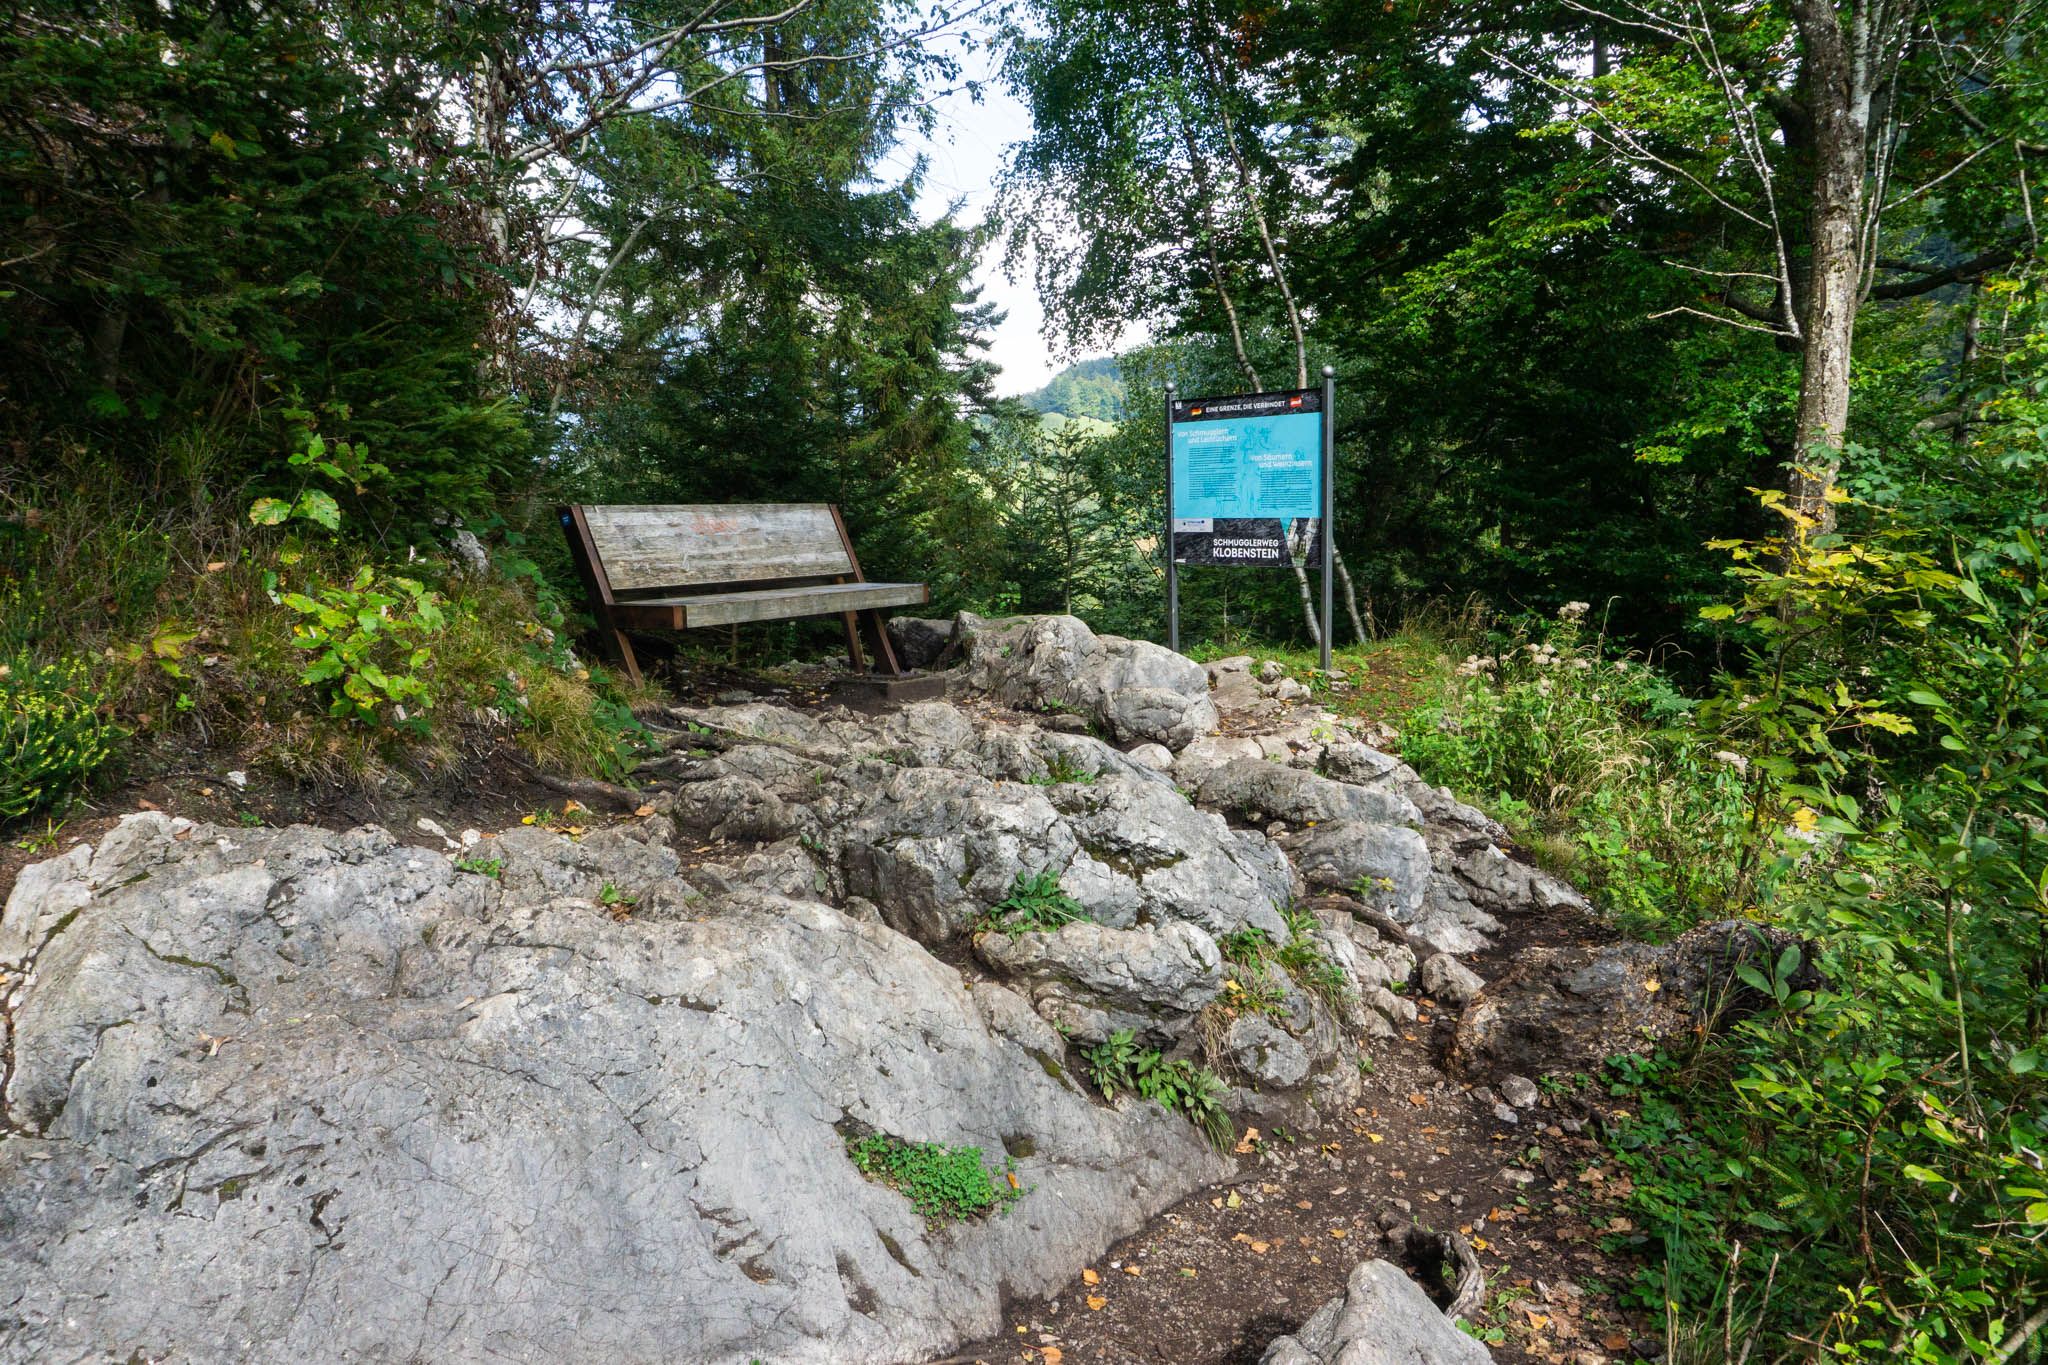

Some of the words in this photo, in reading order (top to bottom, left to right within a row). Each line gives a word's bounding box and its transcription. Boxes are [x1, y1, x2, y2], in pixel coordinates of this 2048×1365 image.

[1219, 404, 1243, 413] GRENZE,
[1253, 400, 1286, 409] VERBINDET
[1213, 538, 1279, 547] SCHMUGGLERWEG
[1213, 547, 1279, 559] KLOBENSTEIN
